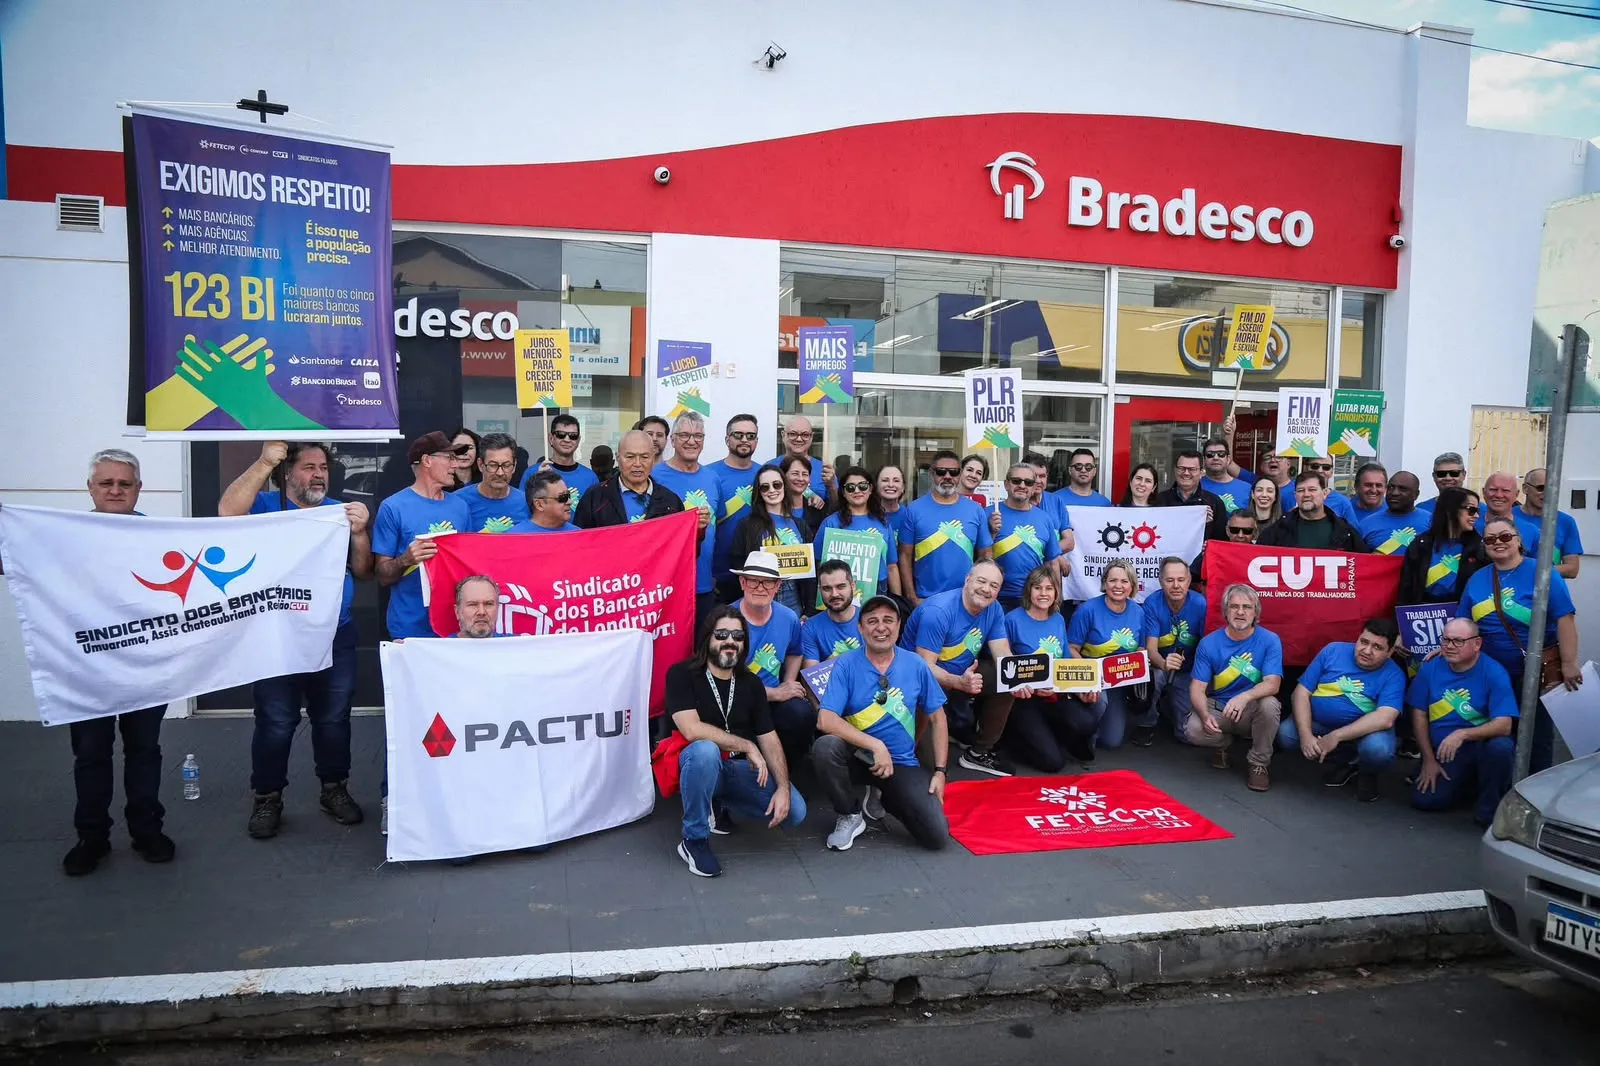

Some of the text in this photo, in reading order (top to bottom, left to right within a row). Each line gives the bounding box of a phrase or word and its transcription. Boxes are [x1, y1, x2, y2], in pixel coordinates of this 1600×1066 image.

[160, 160, 371, 213] EXIGIMOS RESPEITO!
[179, 208, 255, 226] MAIS BANCÁRIOS.
[1068, 175, 1314, 247] Bradesco
[179, 225, 249, 242] MAIS AGÊNCIAS.
[306, 220, 358, 242] É isso que
[180, 241, 282, 260] MELHOR ATENDIMENTO.
[306, 238, 371, 254] a população
[307, 252, 350, 265] precisa.
[164, 271, 275, 321] 123 BI
[282, 282, 375, 303] Foi quanto os cinco
[284, 298, 360, 313] maiores bancos
[284, 310, 364, 326] lucraram juntos.
[394, 297, 520, 341] desco
[1239, 312, 1266, 323] FIM DO
[530, 338, 554, 348] JUROS
[1235, 332, 1260, 344] MORAL
[524, 348, 562, 358] MENORES
[805, 338, 846, 359] MAIS
[1238, 344, 1258, 352] SEXUAL
[301, 356, 379, 366] Santander CAIXA
[532, 360, 554, 370] PARA
[671, 356, 698, 372] LUCRO
[806, 360, 846, 370] EMPREGOS
[336, 378, 357, 386] BRASIL
[526, 370, 562, 381] CRESCER
[670, 368, 708, 387] RESPEITO
[534, 382, 554, 392] MAIS
[972, 376, 1014, 406] PLR
[348, 397, 382, 406] bradesco
[1288, 396, 1321, 418] FIM
[1336, 404, 1378, 414] LUTAR PARA
[974, 406, 1015, 424] MAIOR
[1288, 418, 1320, 426] DAS METAS
[1335, 413, 1378, 424] CONQUISTAR
[1287, 426, 1319, 434] ABUSIVAS
[828, 540, 876, 558] AUMENTO
[1084, 566, 1094, 577] DE
[1143, 568, 1159, 578] REG
[1248, 556, 1347, 590] CUT
[553, 574, 641, 600] Sindicato
[1275, 590, 1292, 598] ÚNICA
[290, 602, 308, 610] CUT
[554, 584, 674, 620] dos Bancário
[75, 585, 312, 644] SINDICATO DOS BANCÁRIOS
[584, 608, 662, 633] Londrin
[1405, 610, 1447, 620] TRABALHAR
[82, 636, 149, 654] Umuarama,
[152, 626, 179, 640] Assis
[181, 605, 256, 633] Chateaubriand
[259, 605, 265, 613] e
[1108, 661, 1140, 673] VALORIZAÇÃO
[1060, 672, 1067, 680] DE
[1068, 672, 1076, 680] VA
[1078, 672, 1082, 680] E
[465, 710, 623, 752] PACTU
